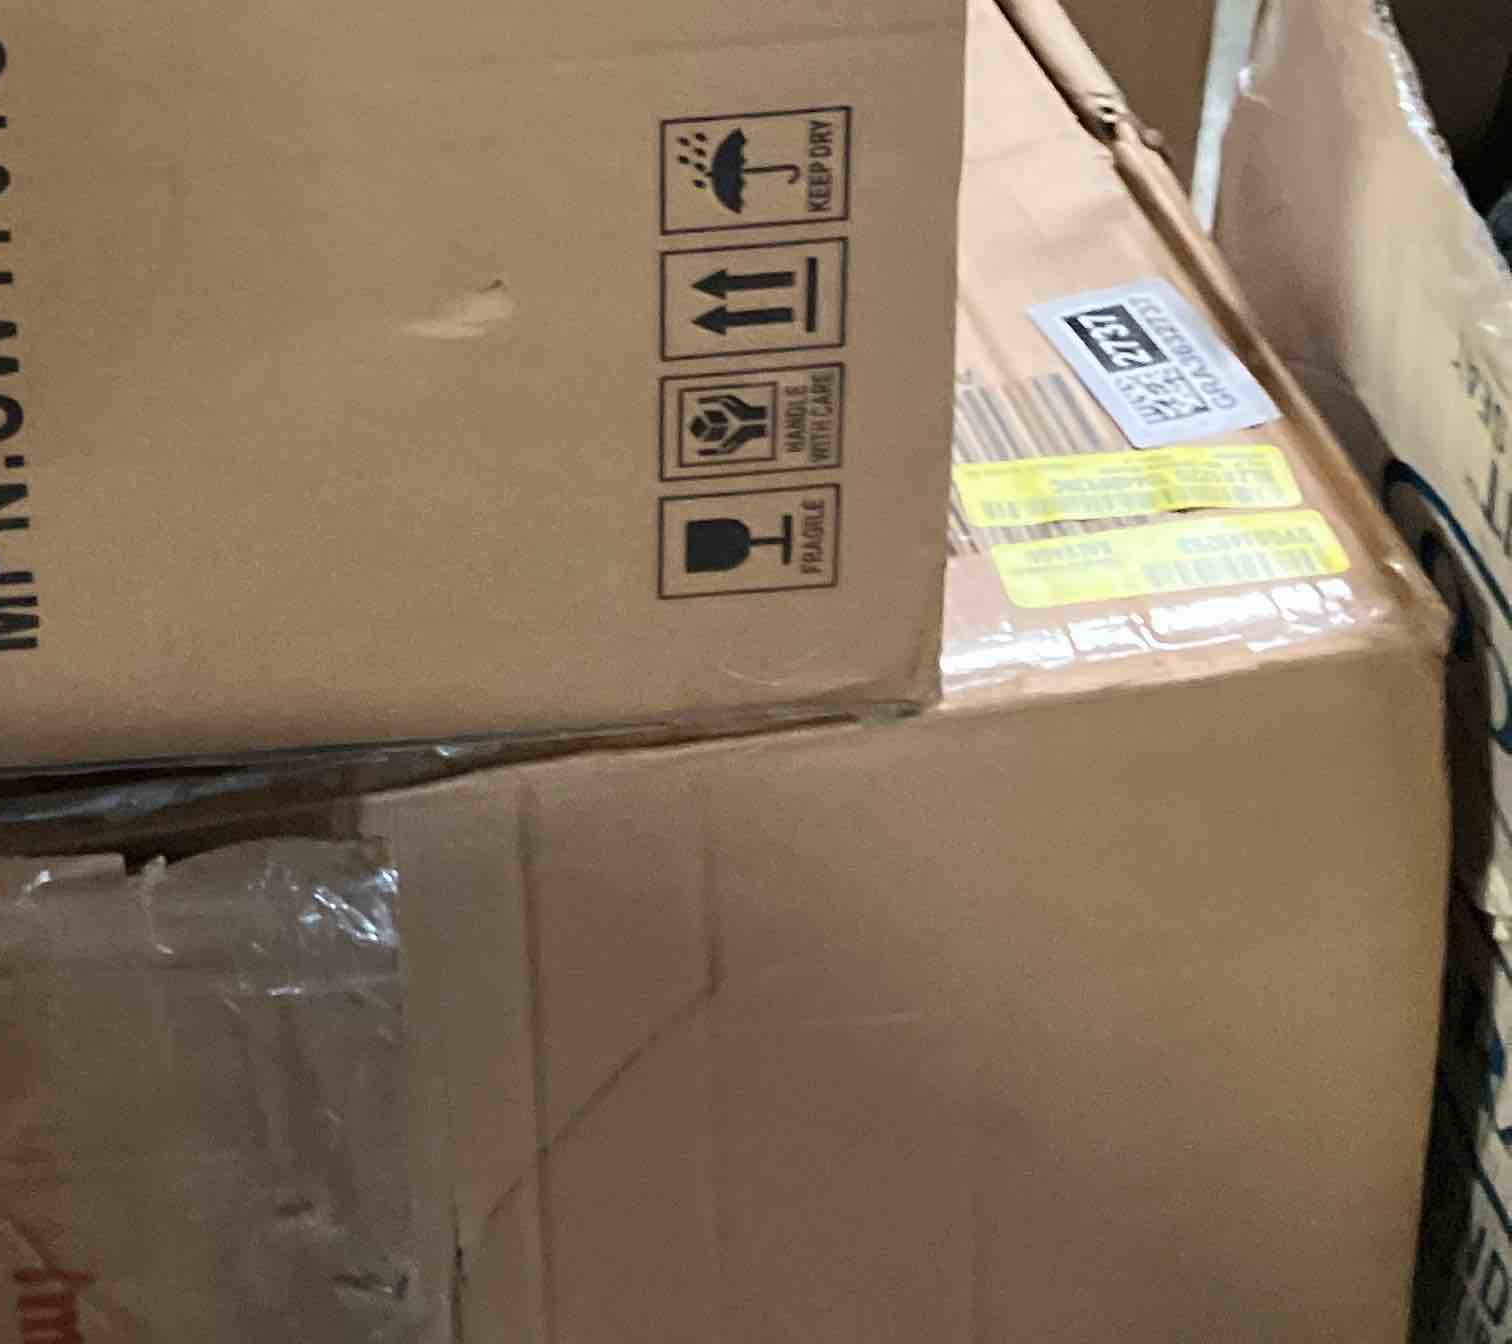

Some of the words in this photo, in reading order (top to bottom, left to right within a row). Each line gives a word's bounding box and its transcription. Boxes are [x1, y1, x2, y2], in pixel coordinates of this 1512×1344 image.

[809, 120, 833, 158] DRY
[807, 162, 832, 213] KEEP
[811, 373, 835, 416] CARE
[785, 385, 808, 453] HANDLE
[810, 419, 832, 462] WITH
[801, 499, 825, 575] FRAGILE
